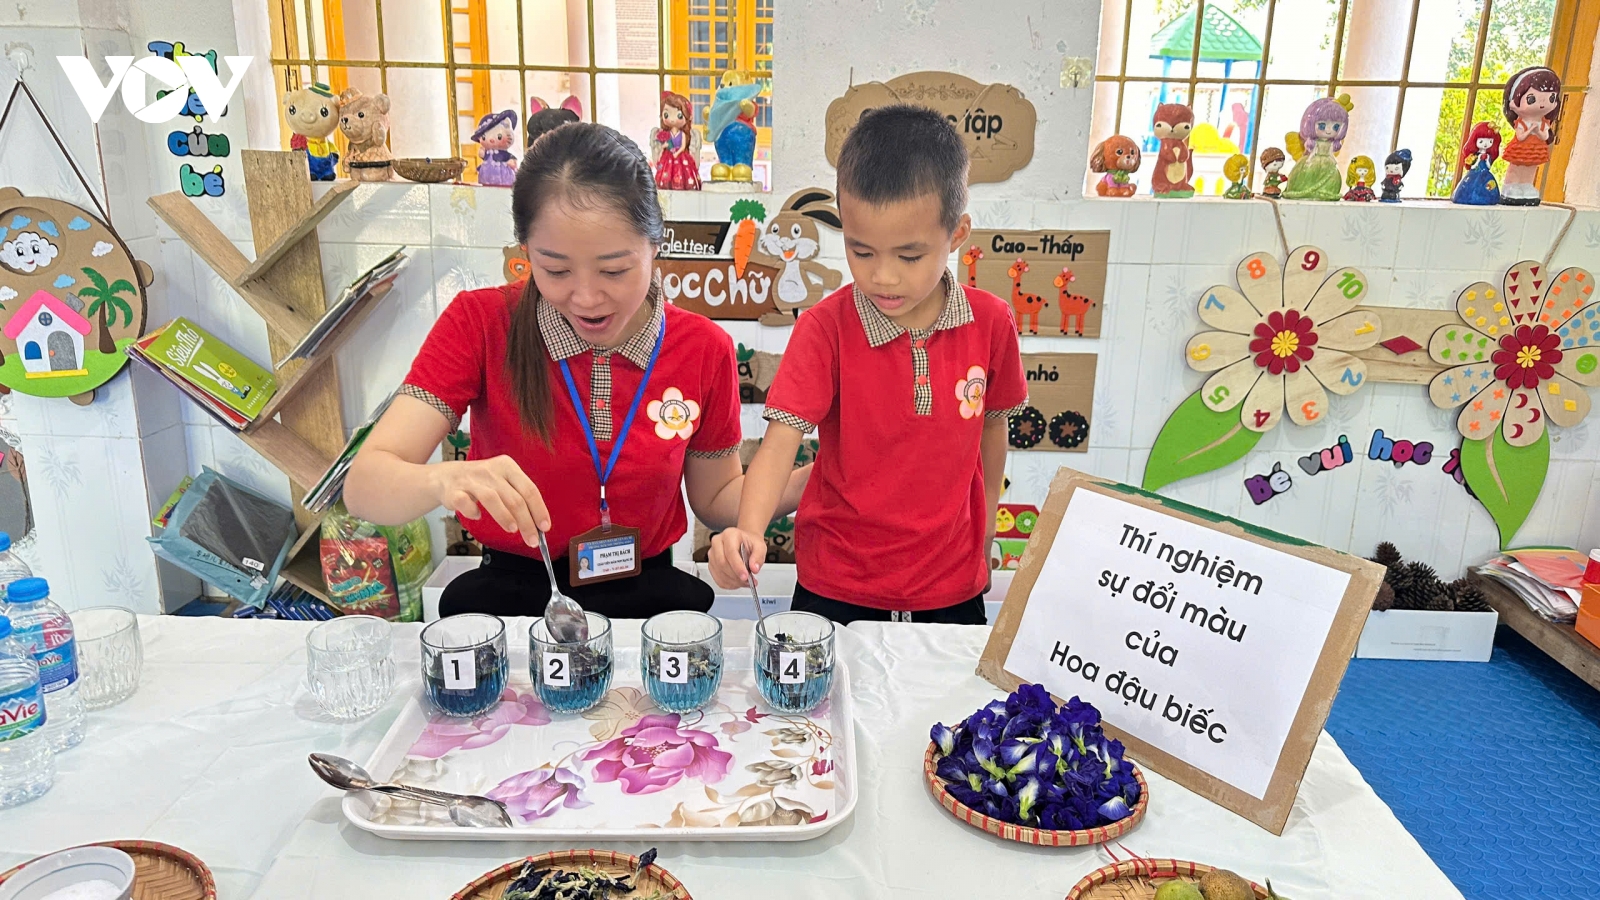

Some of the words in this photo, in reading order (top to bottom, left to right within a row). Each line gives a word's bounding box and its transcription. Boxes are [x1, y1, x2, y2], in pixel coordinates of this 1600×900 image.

[964, 109, 1003, 140] tập
[168, 125, 230, 157] của
[180, 163, 225, 197] bé
[658, 238, 716, 256] gletters
[1246, 258, 1266, 280] 8
[1301, 250, 1320, 271] 9
[663, 272, 701, 305] ọc
[1336, 271, 1364, 299] 10
[1204, 293, 1226, 311] 7
[1354, 321, 1375, 336] 1
[1190, 343, 1211, 361] 6
[1026, 364, 1059, 381] nhỏ
[1340, 367, 1362, 387] 2
[1208, 386, 1230, 405] 5
[1253, 409, 1271, 428] 4
[1301, 400, 1320, 421] 3
[1244, 461, 1292, 505] Bé
[1298, 434, 1353, 476] vui
[1368, 429, 1434, 469] học
[1119, 523, 1157, 554] Thí
[1156, 542, 1263, 595] nghiệm
[1098, 569, 1130, 597] sự
[1132, 580, 1178, 613] đổi
[1180, 601, 1247, 642] màu
[1125, 630, 1179, 667] của
[451, 659, 460, 680] 1
[549, 658, 564, 680] 2
[666, 657, 681, 678] 3
[784, 658, 799, 679] 4
[1050, 641, 1100, 682] Hoa
[1105, 670, 1158, 711] đậu
[1162, 694, 1227, 743] biếc
[0, 703, 38, 726] aVie
